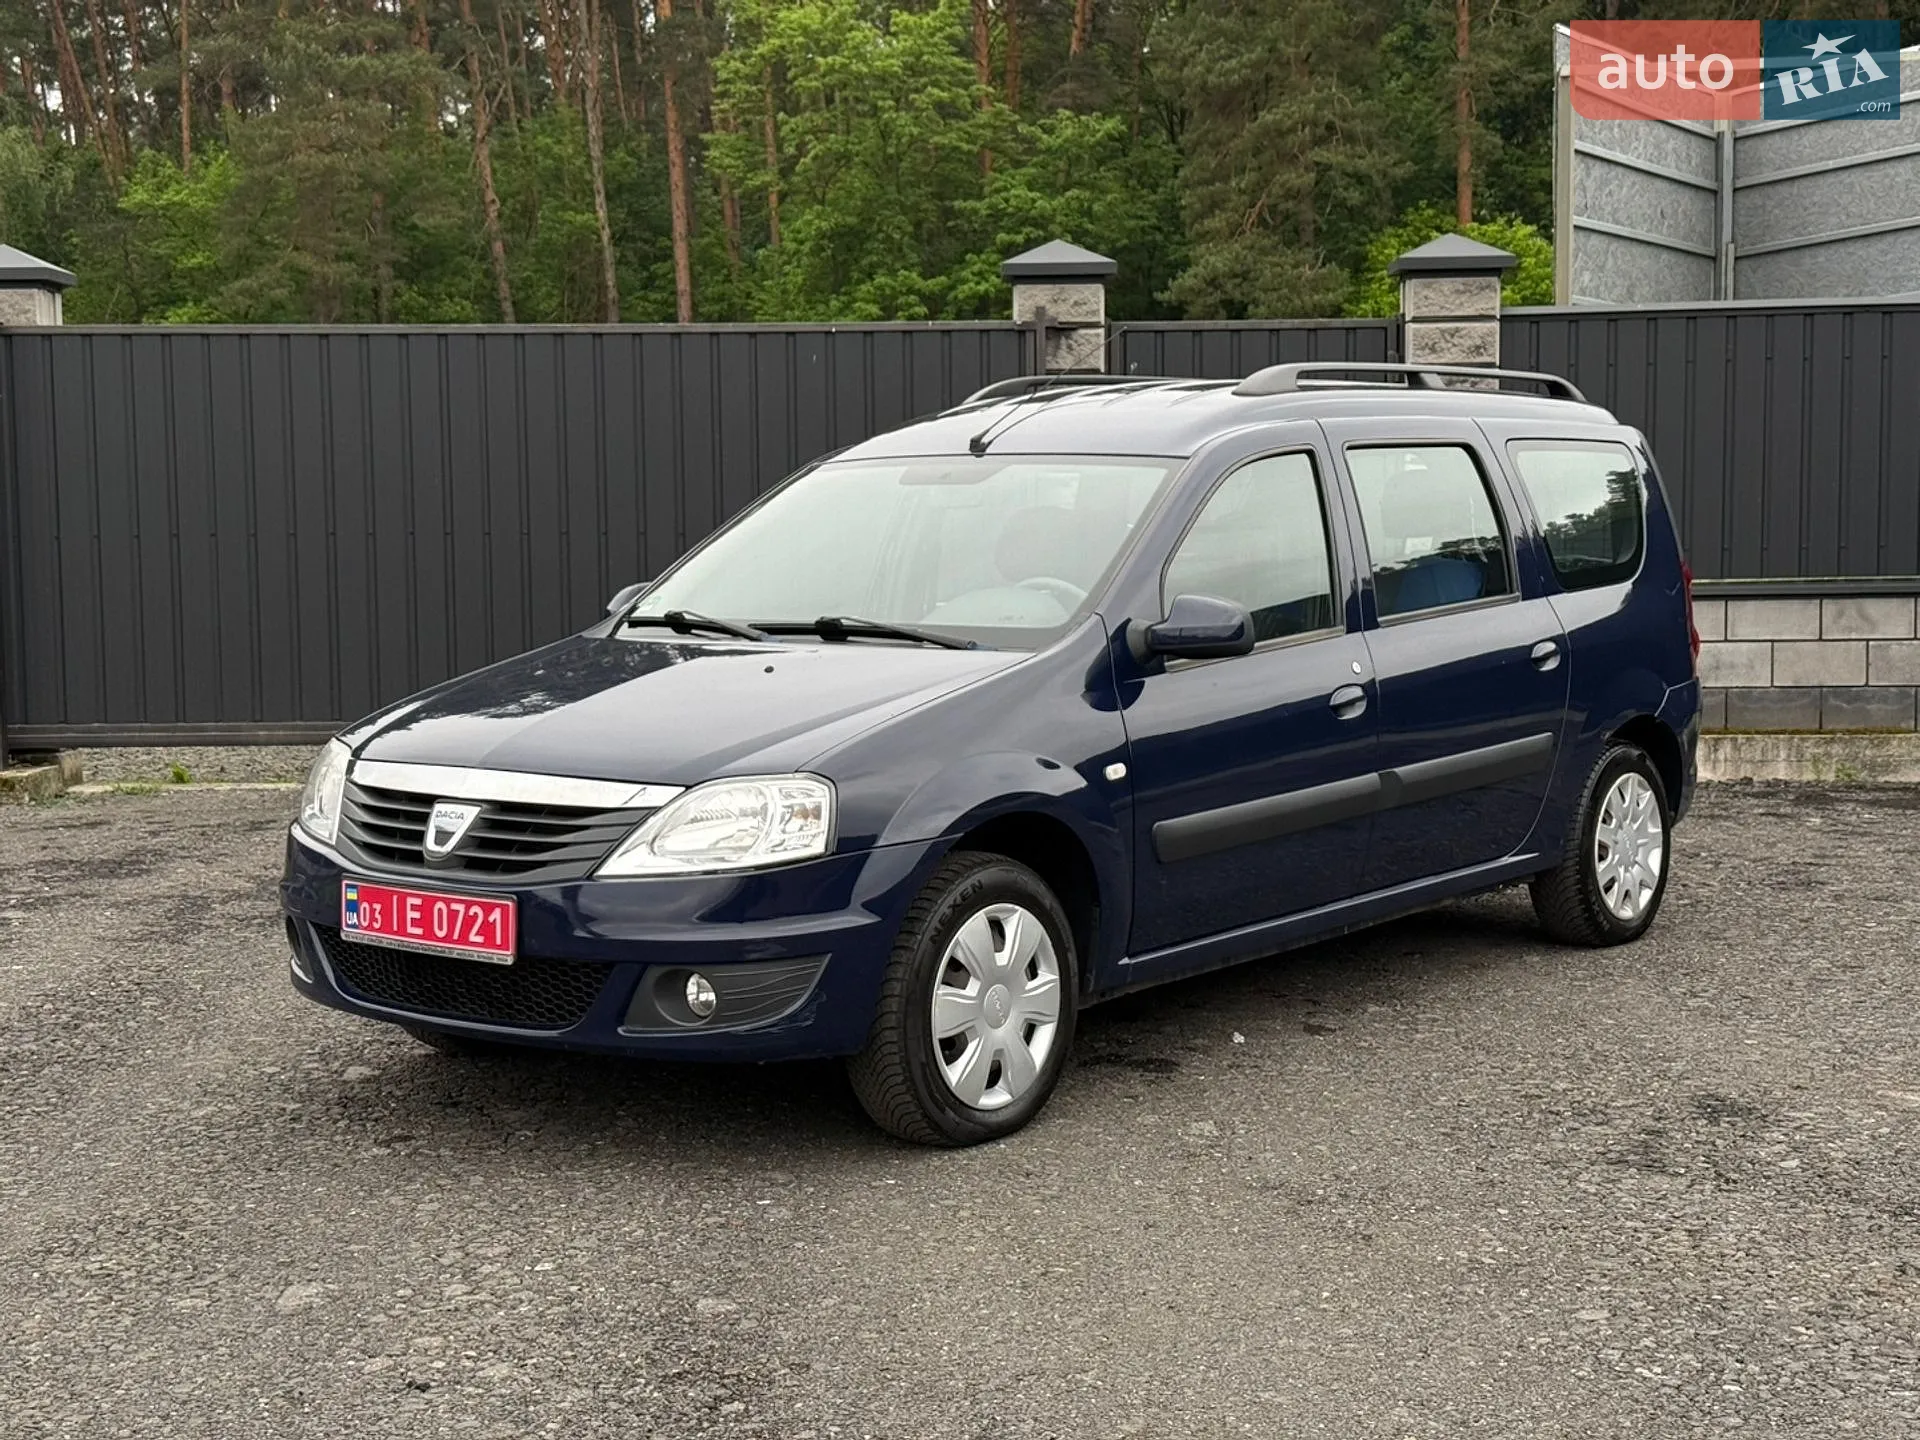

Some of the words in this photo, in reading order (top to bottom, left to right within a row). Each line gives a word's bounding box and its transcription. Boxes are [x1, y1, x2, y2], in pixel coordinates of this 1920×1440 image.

[435, 810, 464, 820] DACIA
[346, 912, 358, 926] UA
[360, 901, 382, 929] 03
[433, 901, 502, 945] 0721
[928, 879, 984, 945] NEXEN
